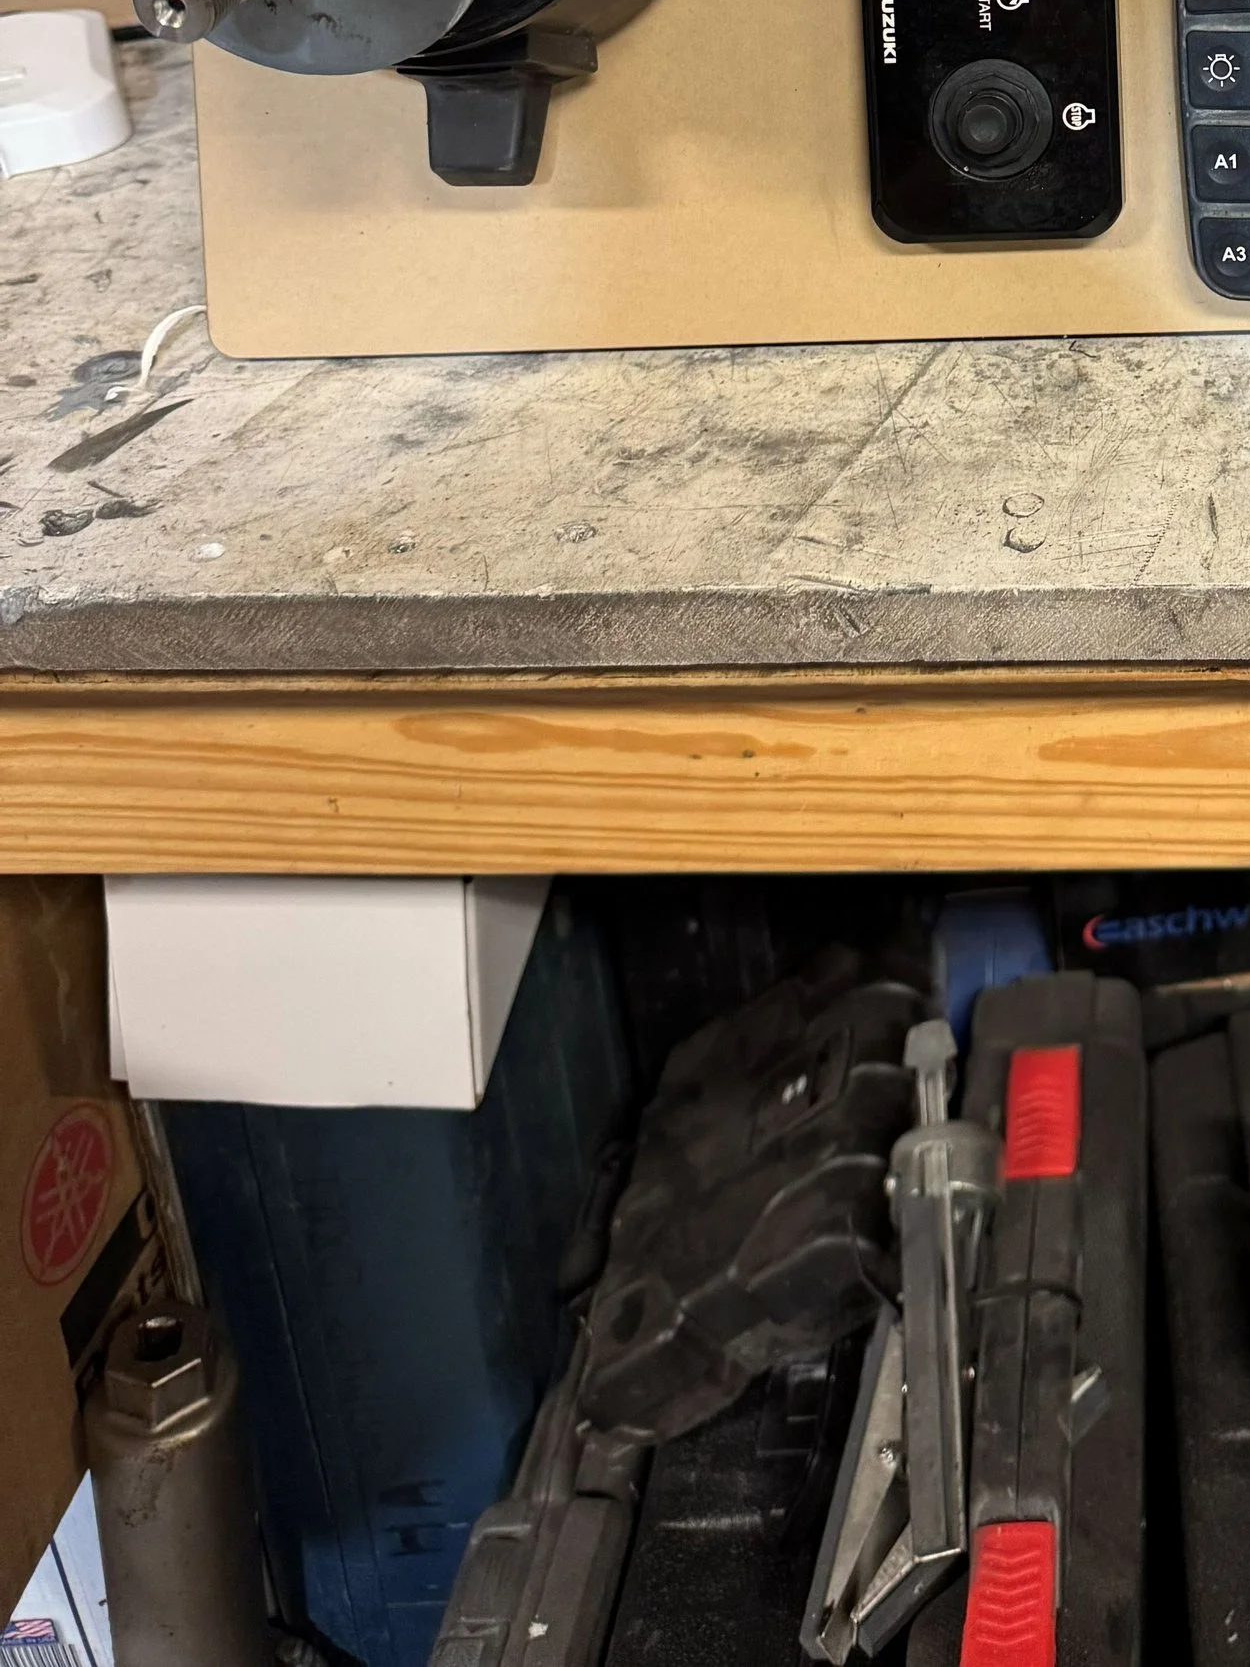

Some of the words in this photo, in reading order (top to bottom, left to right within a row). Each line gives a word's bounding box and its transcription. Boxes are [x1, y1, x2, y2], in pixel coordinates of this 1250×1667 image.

[1070, 105, 1082, 127] STOP
[1214, 154, 1237, 169] A1
[1222, 247, 1246, 262] A3
